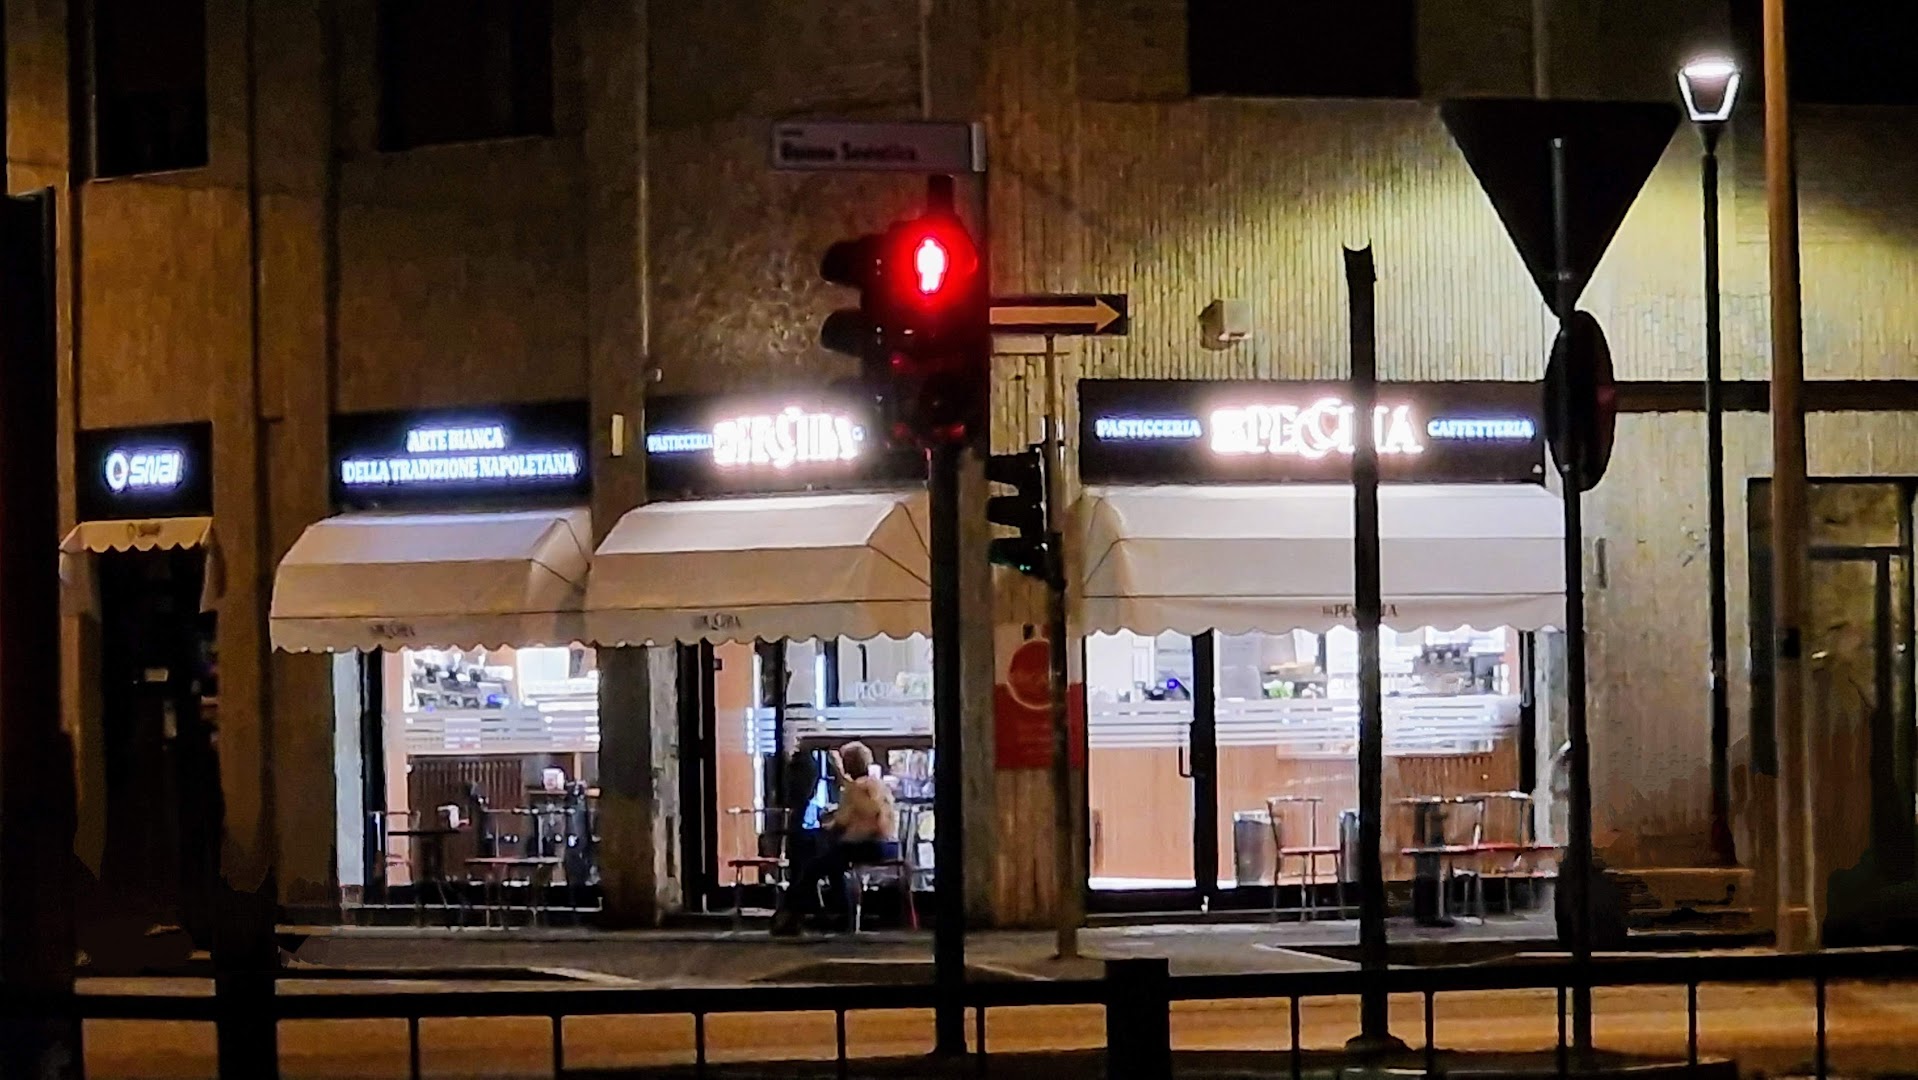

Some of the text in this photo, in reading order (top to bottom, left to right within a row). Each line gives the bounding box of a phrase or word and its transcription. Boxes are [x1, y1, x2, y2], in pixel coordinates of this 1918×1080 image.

[1096, 419, 1202, 437] PASTICCERIA
[1428, 418, 1535, 438] CAFFETTERIA
[407, 427, 505, 452] ARTE BIANCA
[342, 452, 577, 483] DELLA TRADIZIONE NAPOLETANA
